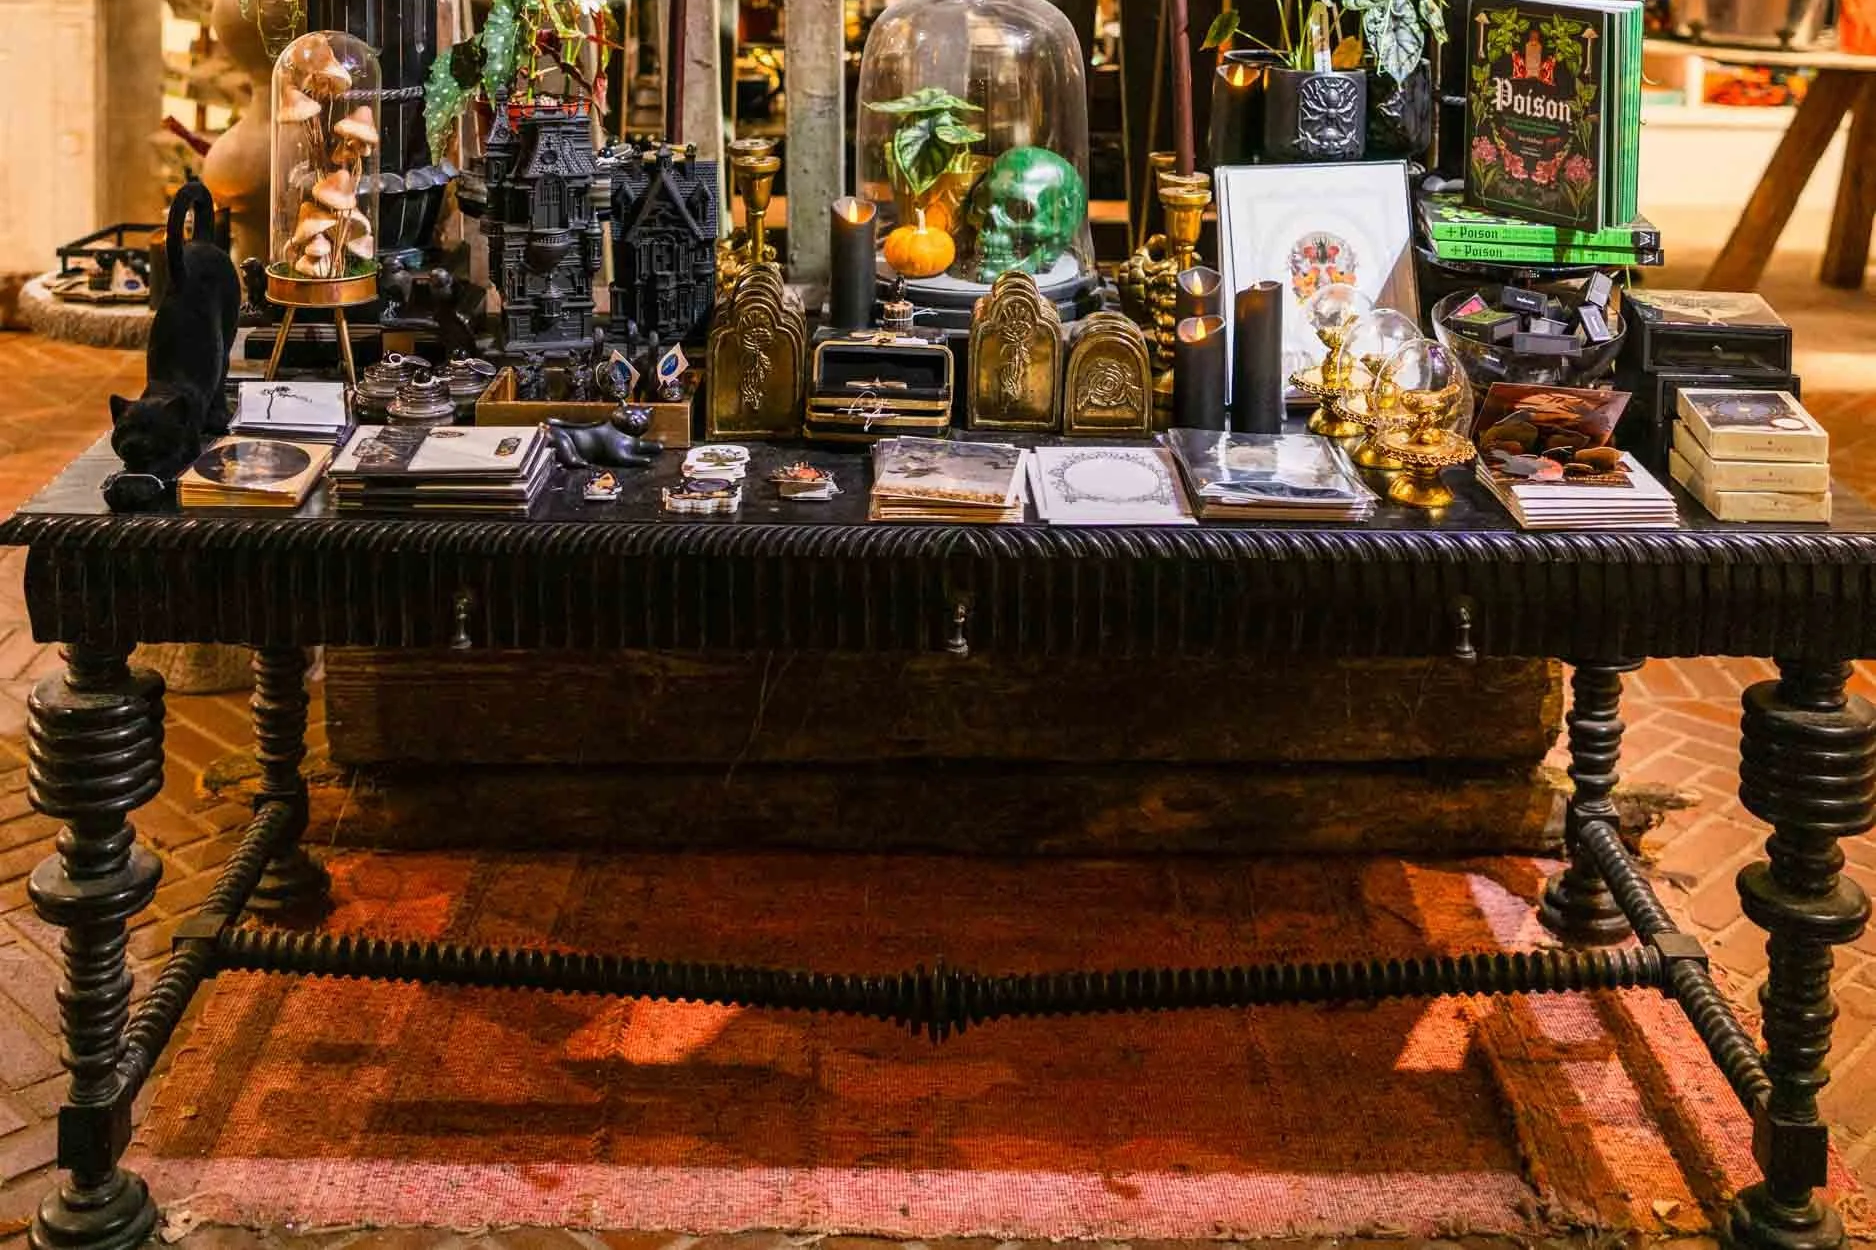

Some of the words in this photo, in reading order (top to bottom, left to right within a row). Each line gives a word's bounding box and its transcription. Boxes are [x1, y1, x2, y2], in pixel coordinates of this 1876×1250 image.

[1490, 77, 1573, 125] Poison
[1459, 226, 1498, 240] Poison
[1463, 244, 1503, 258] Poison
